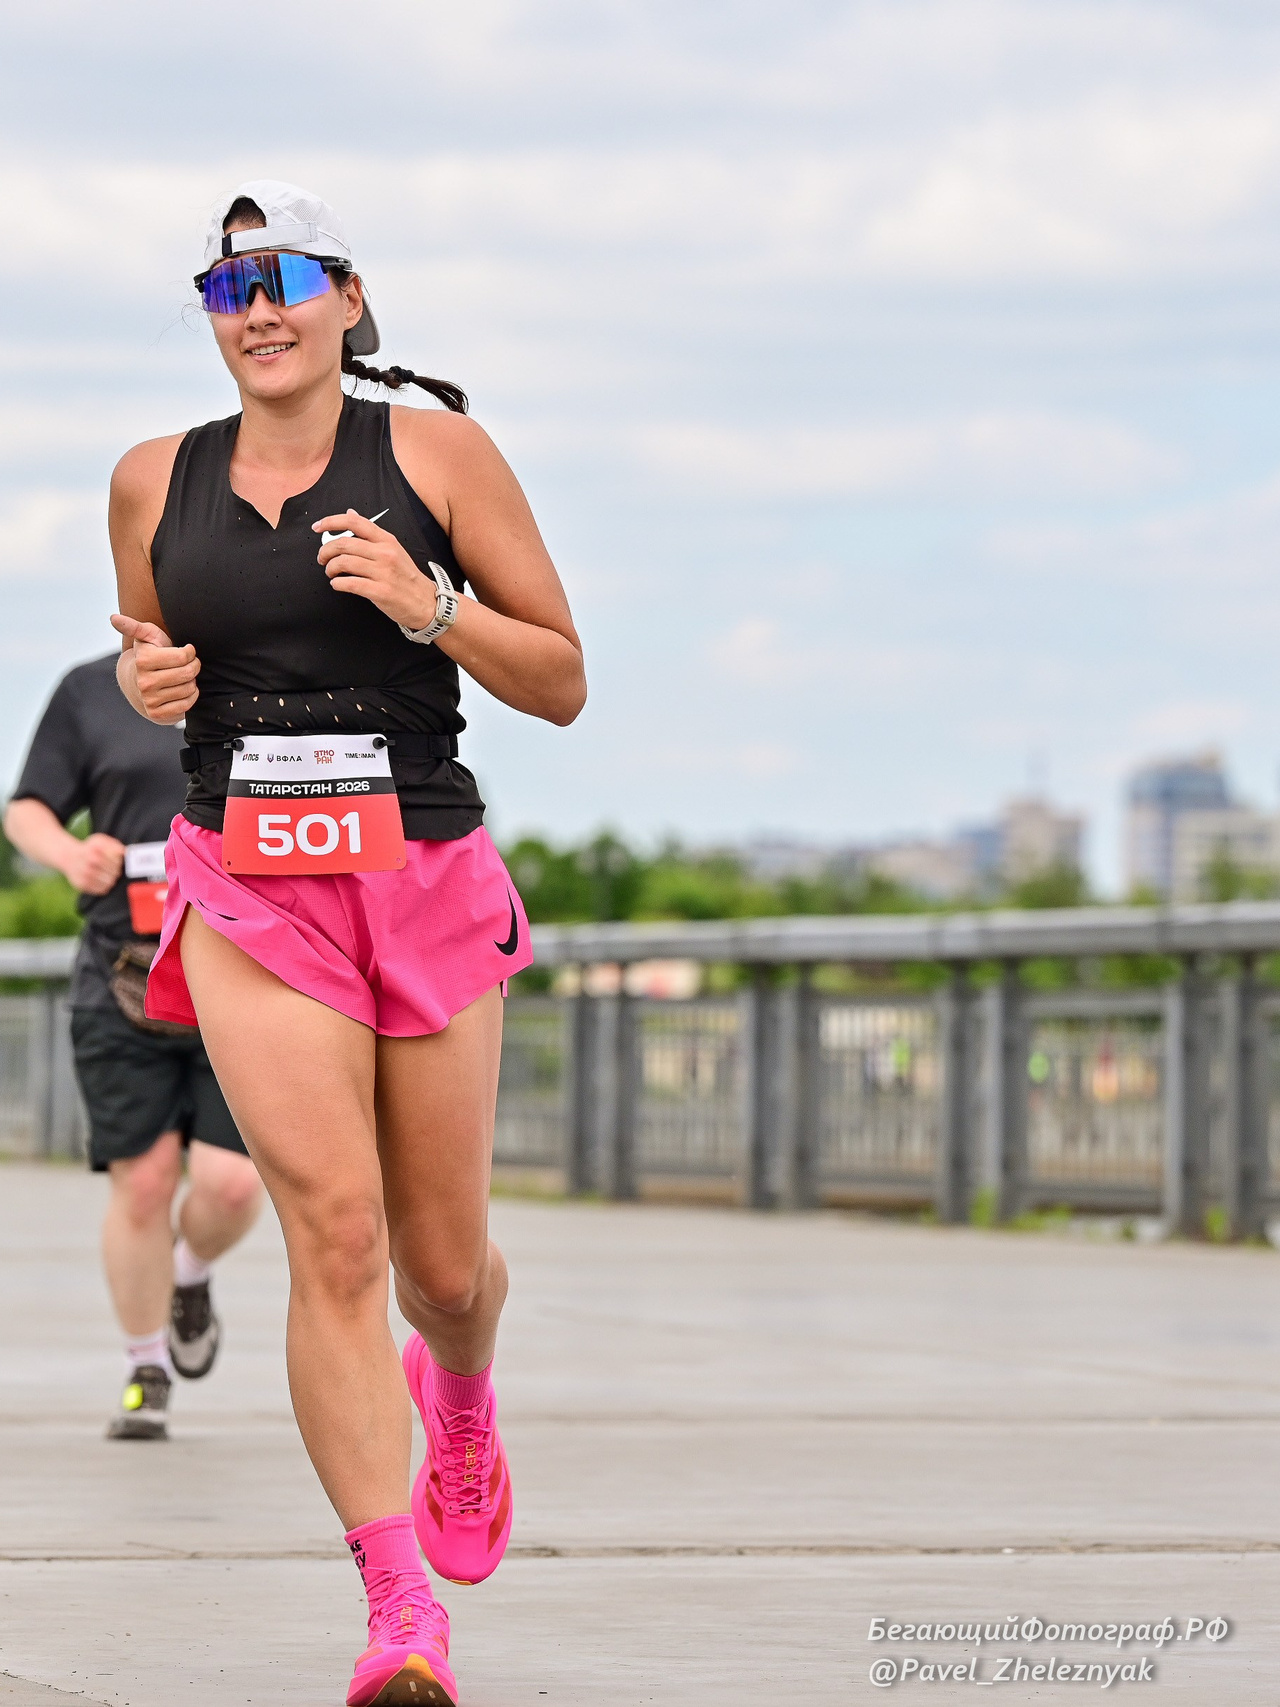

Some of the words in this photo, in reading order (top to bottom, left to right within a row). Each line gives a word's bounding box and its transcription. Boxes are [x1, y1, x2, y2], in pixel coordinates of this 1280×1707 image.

[276, 755, 303, 763] ВФЛА
[248, 782, 332, 795] ТАТАРСТАН
[336, 780, 370, 793] 2026
[257, 811, 362, 857] 501
